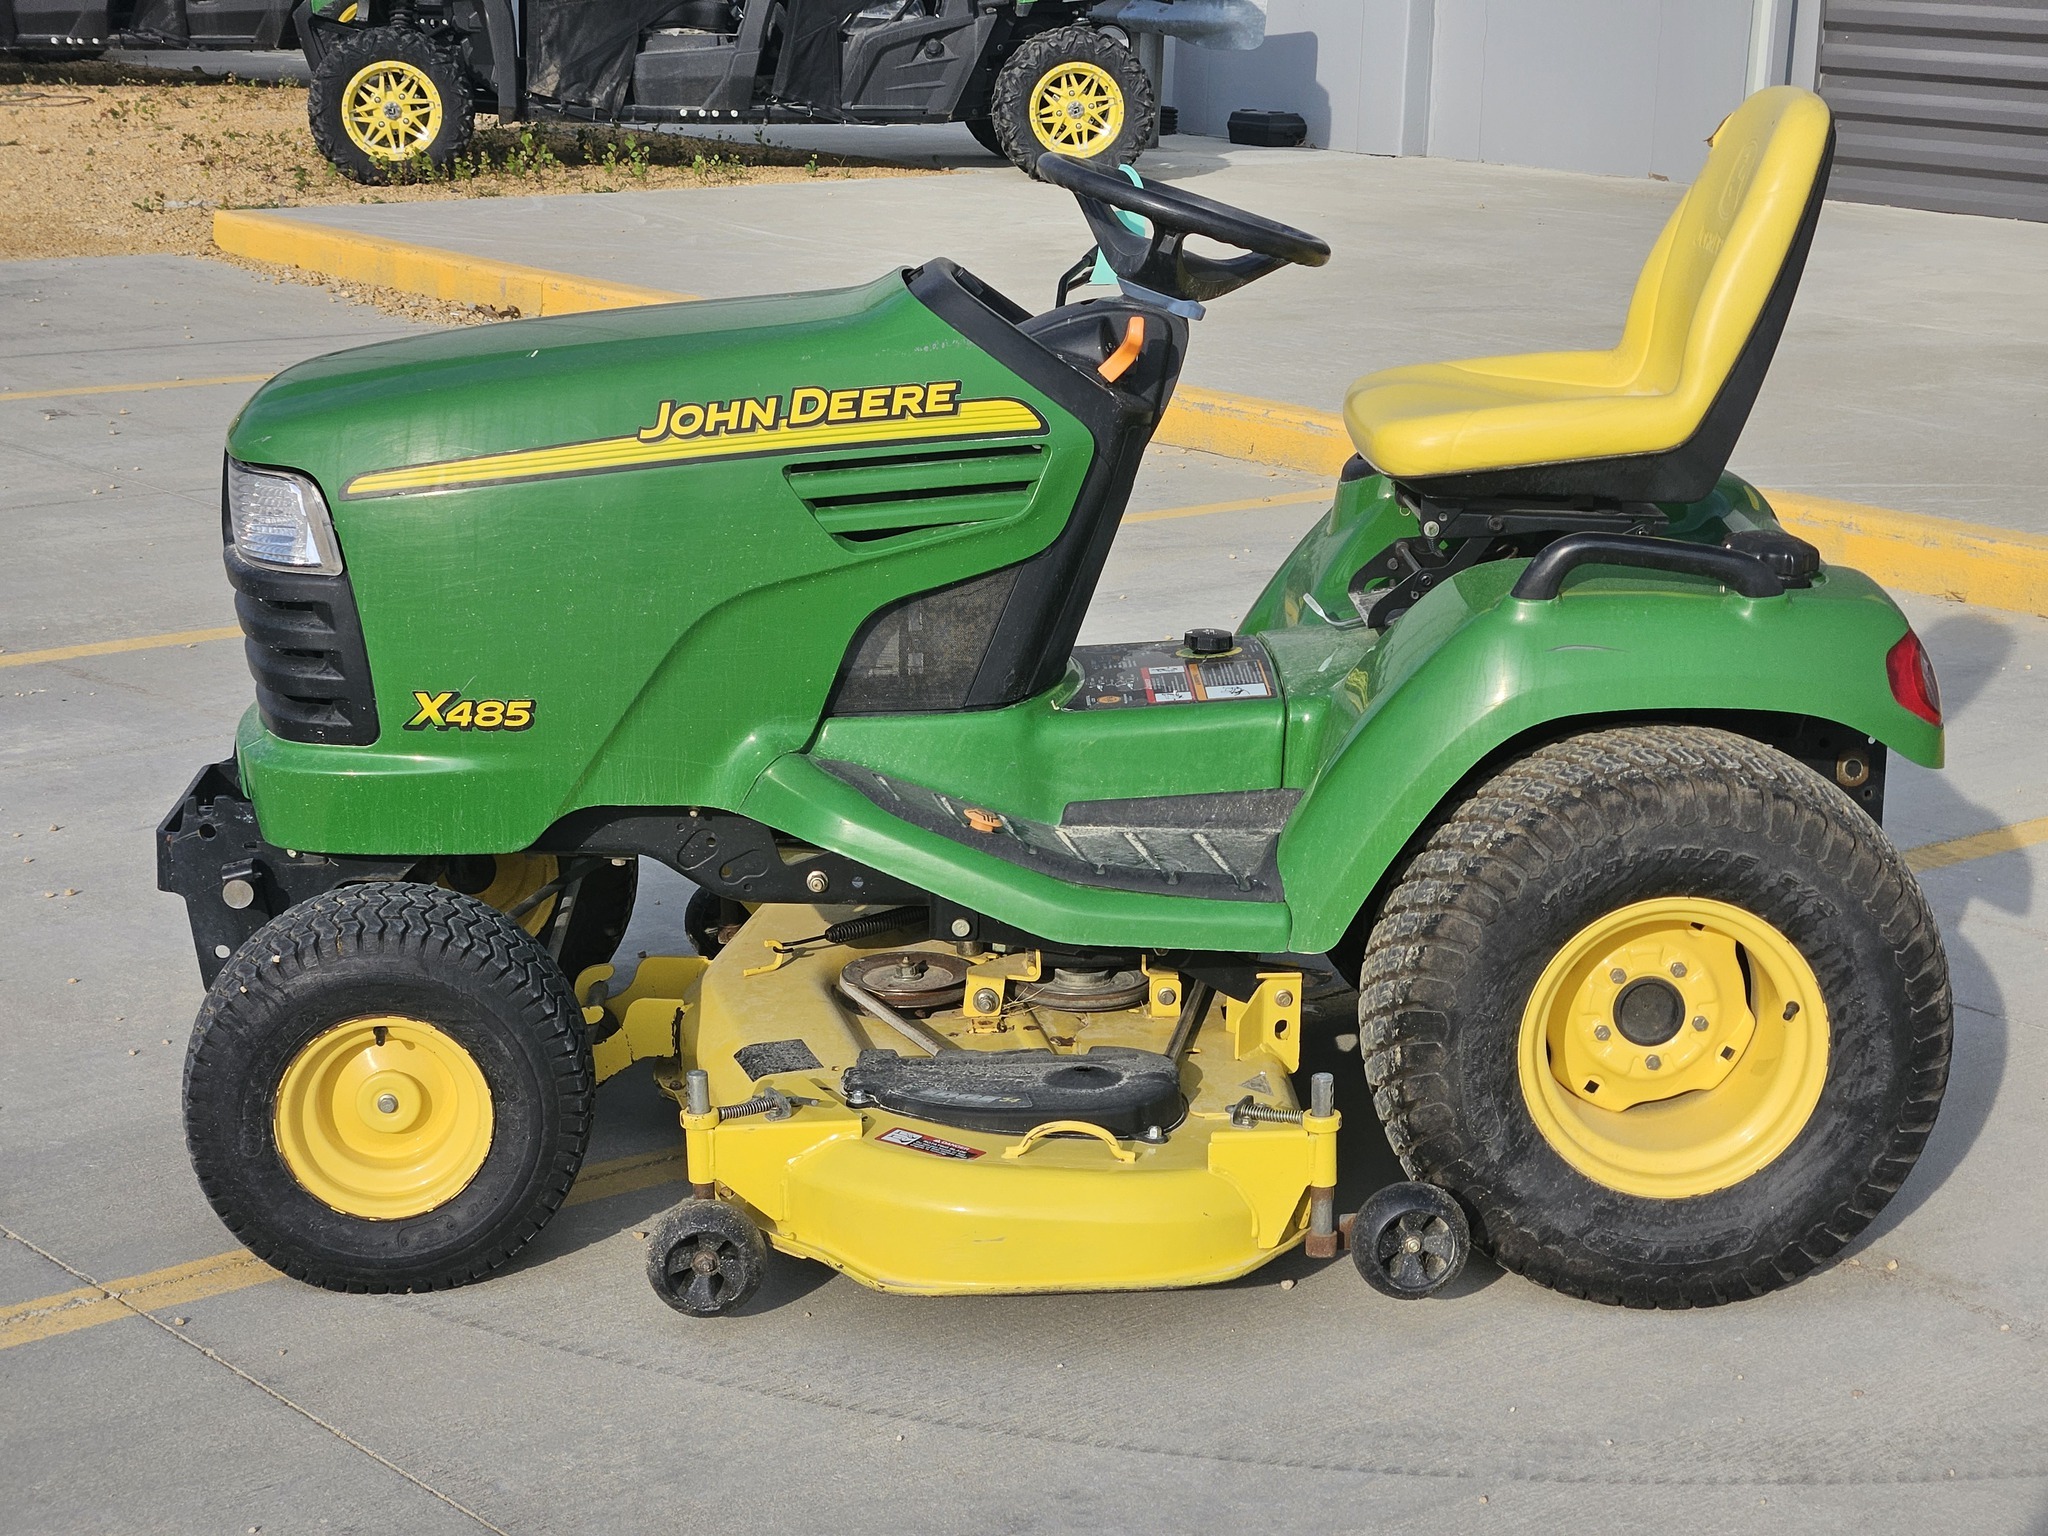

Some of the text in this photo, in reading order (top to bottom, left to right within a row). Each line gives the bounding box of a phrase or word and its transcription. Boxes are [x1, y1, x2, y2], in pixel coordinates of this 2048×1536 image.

[638, 380, 962, 443] JOHN DEERE
[403, 690, 537, 731] X485
